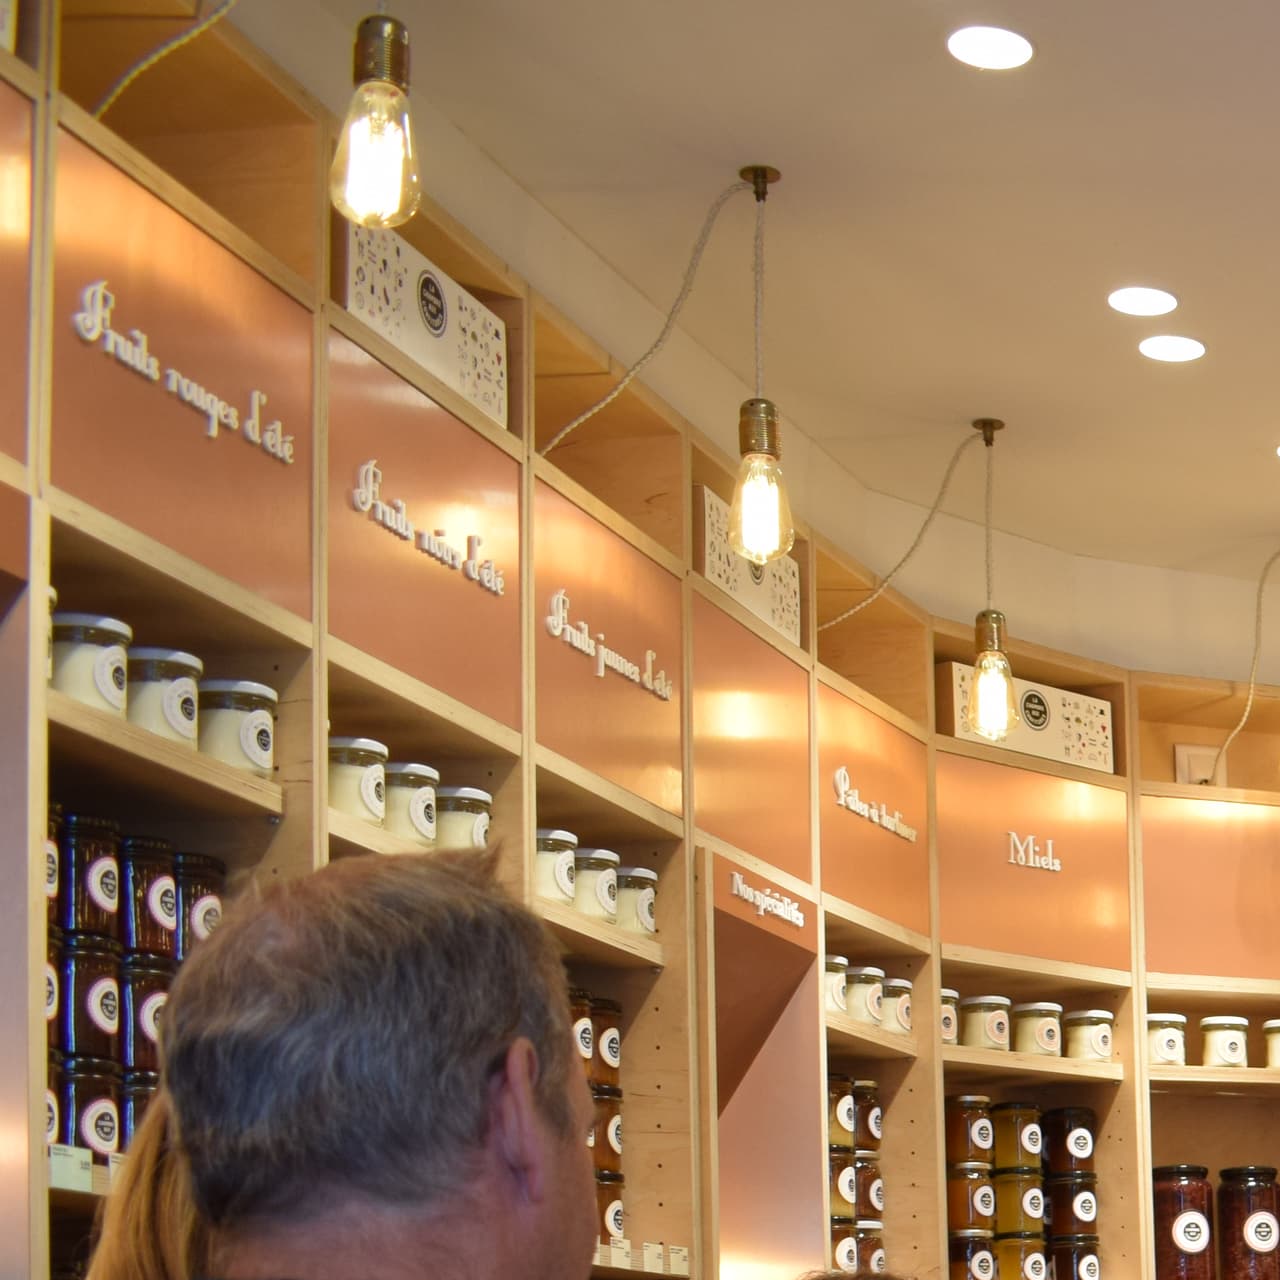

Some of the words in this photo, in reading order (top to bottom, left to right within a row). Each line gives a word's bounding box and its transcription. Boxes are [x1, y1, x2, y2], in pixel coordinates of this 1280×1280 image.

[73, 279, 160, 381] Fruits
[165, 368, 239, 438] rouges
[244, 390, 295, 464] d'été
[352, 459, 414, 541] Fruits
[545, 588, 596, 657] Fruits
[596, 633, 641, 678] jaunes
[1008, 831, 1061, 872] Miels
[731, 872, 753, 903] Nos
[753, 888, 805, 928] spécialités
